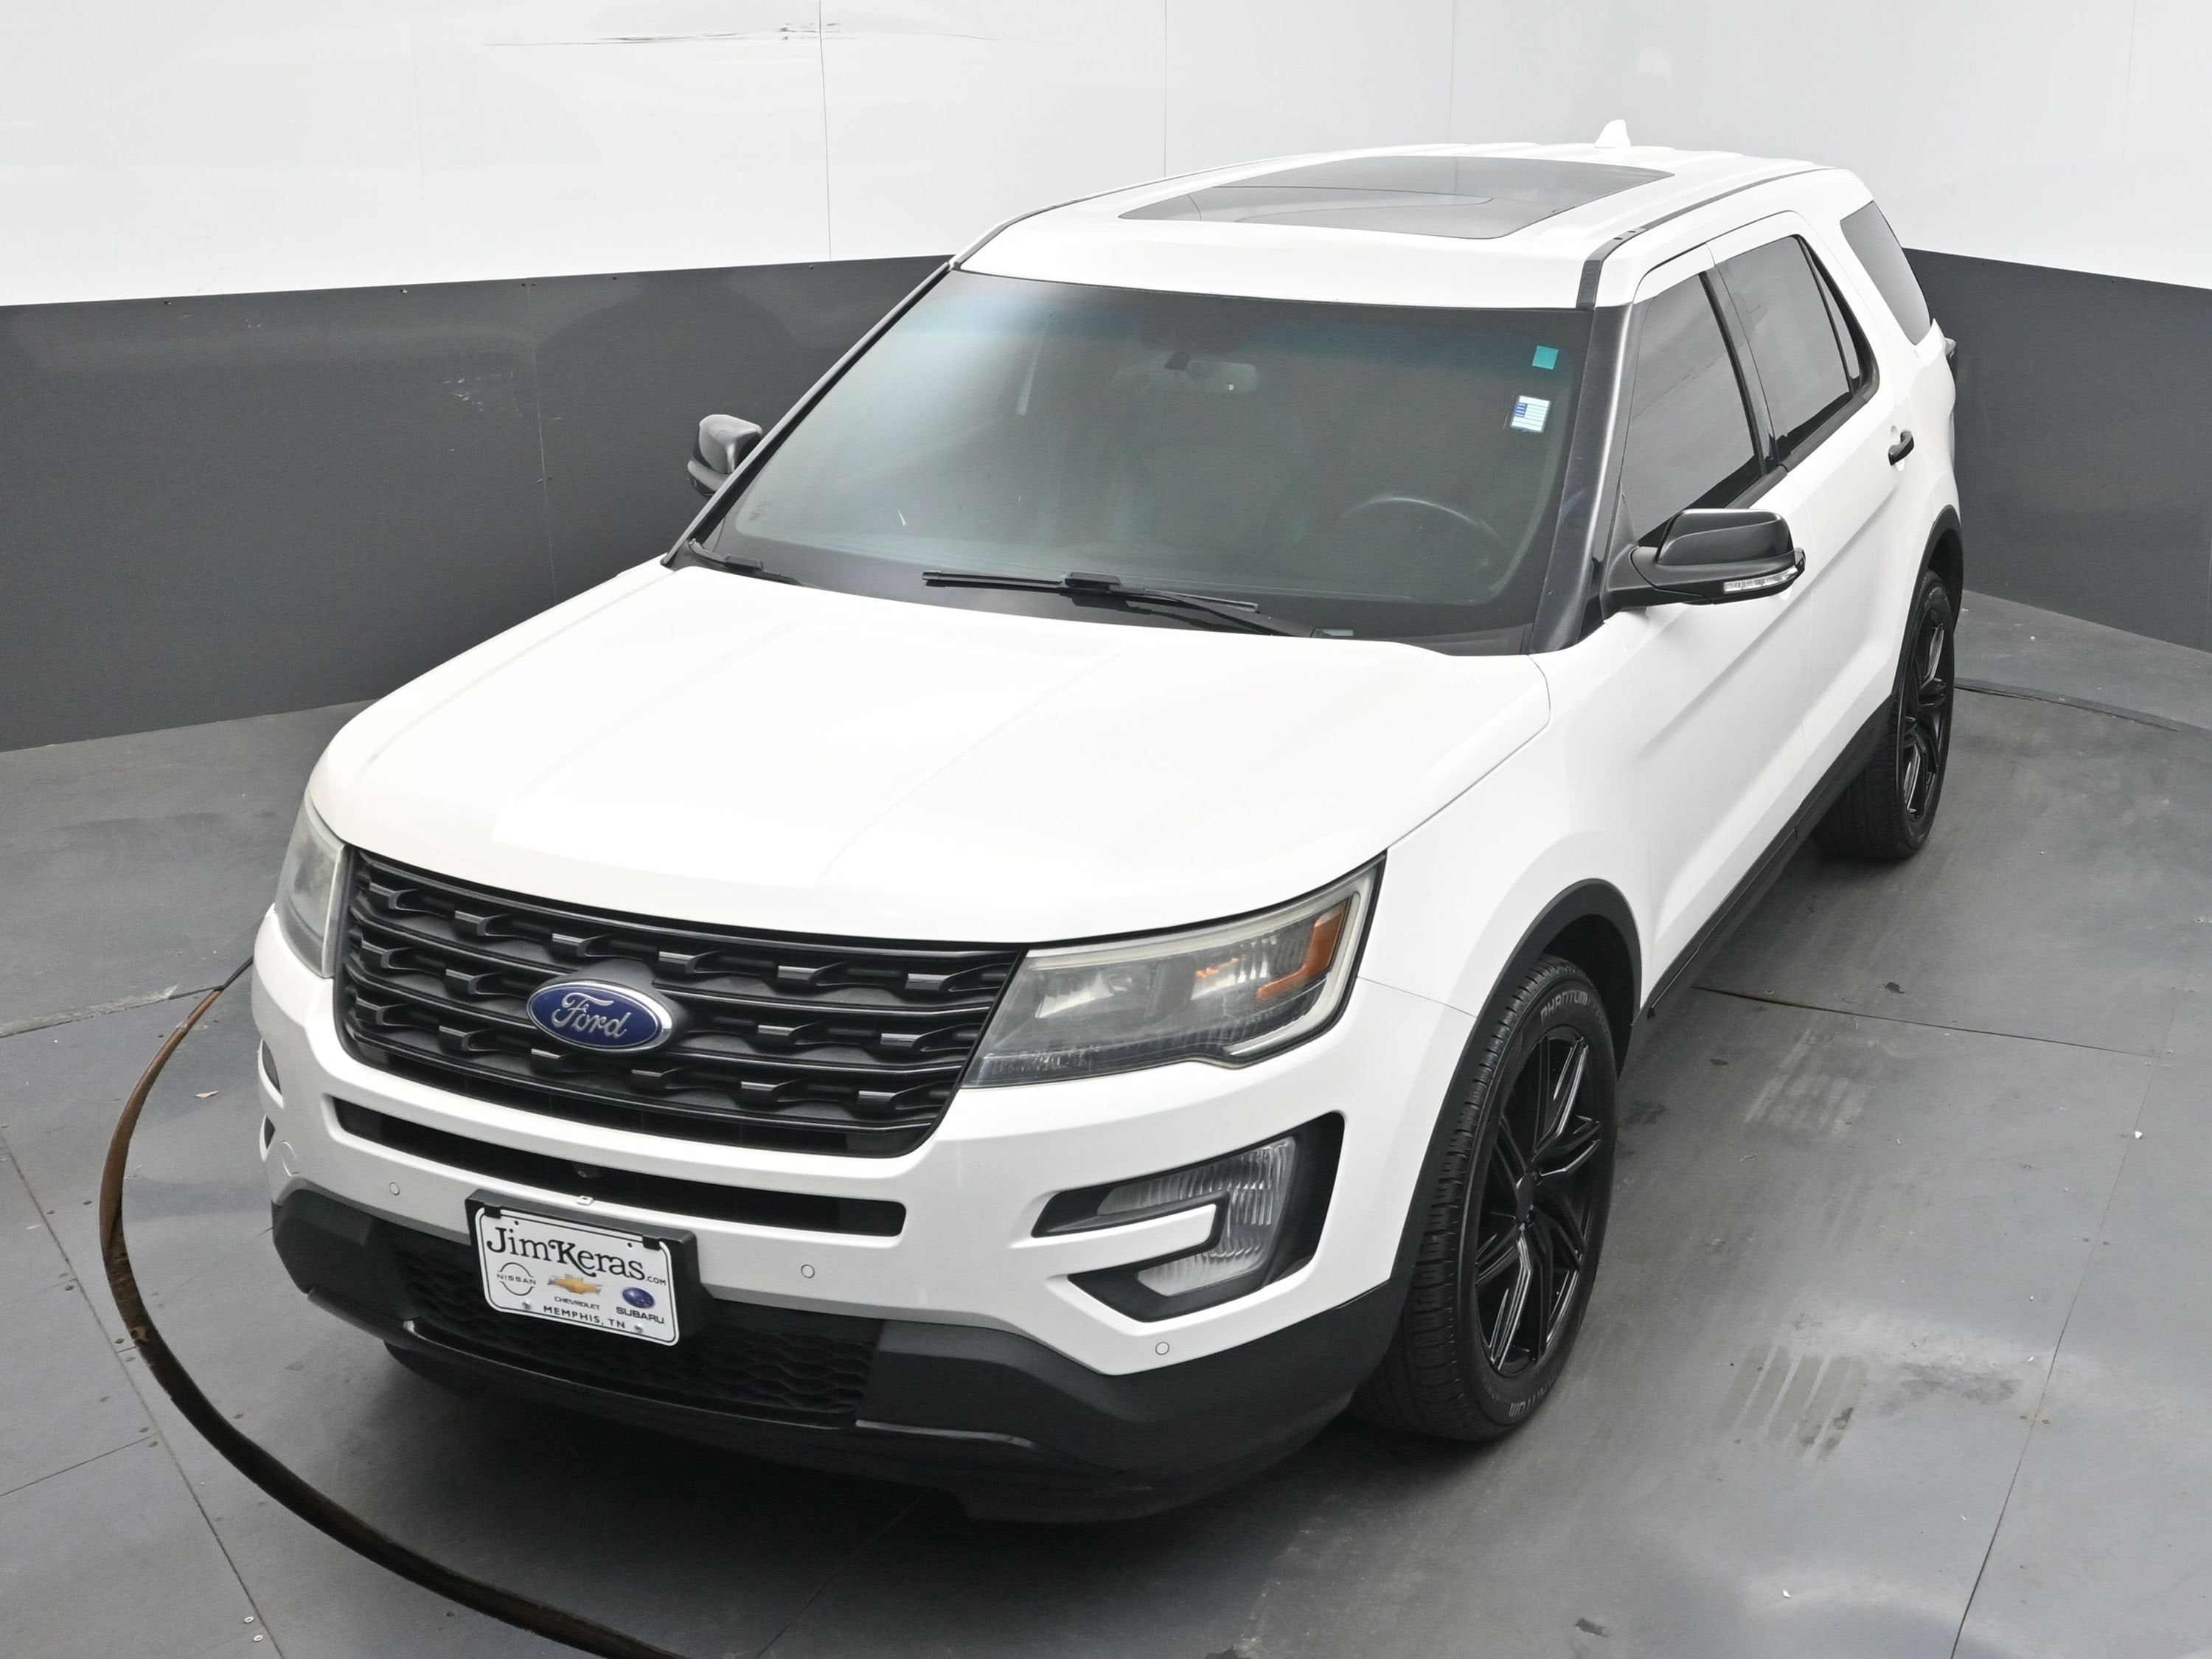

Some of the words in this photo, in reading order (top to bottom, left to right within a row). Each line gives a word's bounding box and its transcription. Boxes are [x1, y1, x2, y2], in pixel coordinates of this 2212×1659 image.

[551, 992, 632, 1038] Ford
[496, 1273, 537, 1286] NISSAN
[554, 1295, 602, 1310] CHEVROLET
[543, 1305, 604, 1326] MEMPHIS,
[608, 1318, 626, 1329] TN
[616, 1307, 665, 1324] SUBARU
